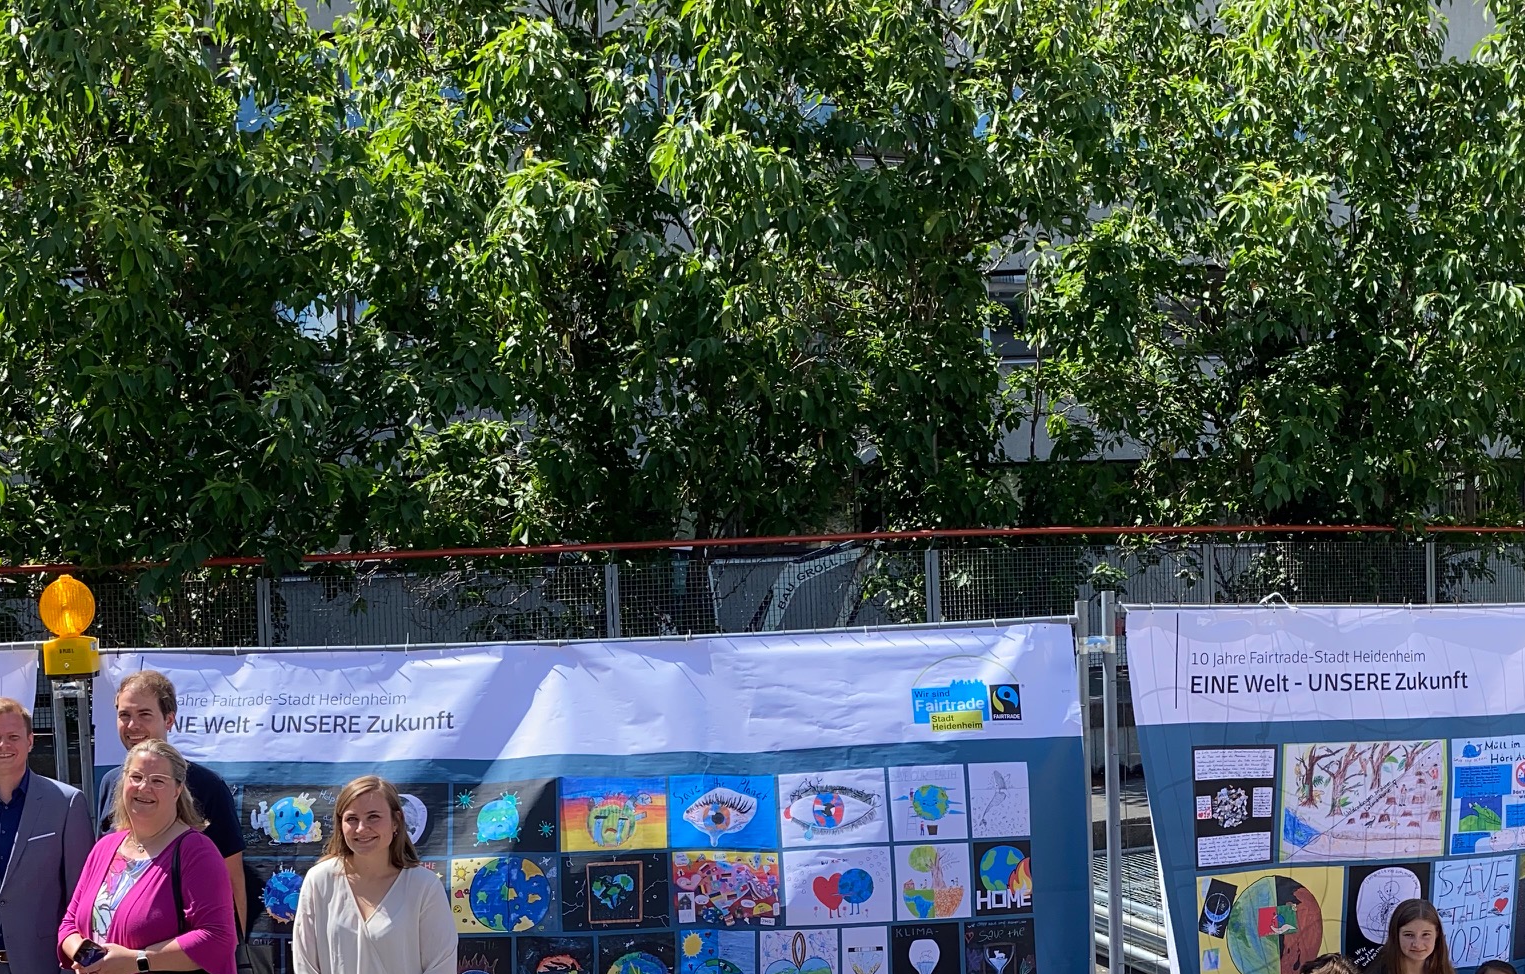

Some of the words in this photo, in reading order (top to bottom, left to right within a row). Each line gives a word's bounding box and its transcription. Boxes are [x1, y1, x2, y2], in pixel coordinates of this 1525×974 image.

[778, 583, 795, 610] BAU
[796, 559, 839, 581] GROLL
[1191, 652, 1209, 665] 10
[1213, 652, 1246, 668] Jahre
[1249, 650, 1350, 664] Fairtrade-Stadt
[1353, 649, 1426, 663] Heidenheim
[1190, 675, 1239, 694] EINE
[1244, 674, 1290, 693] Welt
[1308, 672, 1392, 692] UNSERE
[1395, 670, 1469, 691] Zukunft
[176, 693, 209, 708] ahre
[212, 693, 316, 708] Fairtrade-Stadt
[319, 692, 407, 707] Heidenheim
[914, 690, 929, 699] Wir
[931, 690, 950, 698] sind
[915, 698, 985, 712] Fairtrade
[204, 715, 251, 734] Welt
[271, 714, 361, 734] UNSERE
[366, 710, 455, 734] Zukunft
[931, 715, 954, 723] Stadt
[932, 721, 983, 732] Heidenheim
[1484, 740, 1506, 751] Müll
[1511, 740, 1521, 749] im
[673, 783, 700, 806] Save
[740, 777, 769, 802] Planet
[1438, 858, 1513, 898] SAVE
[975, 888, 1032, 912] HOME
[1449, 904, 1491, 926] THE
[978, 929, 1004, 943] Save
[1007, 927, 1025, 938] the
